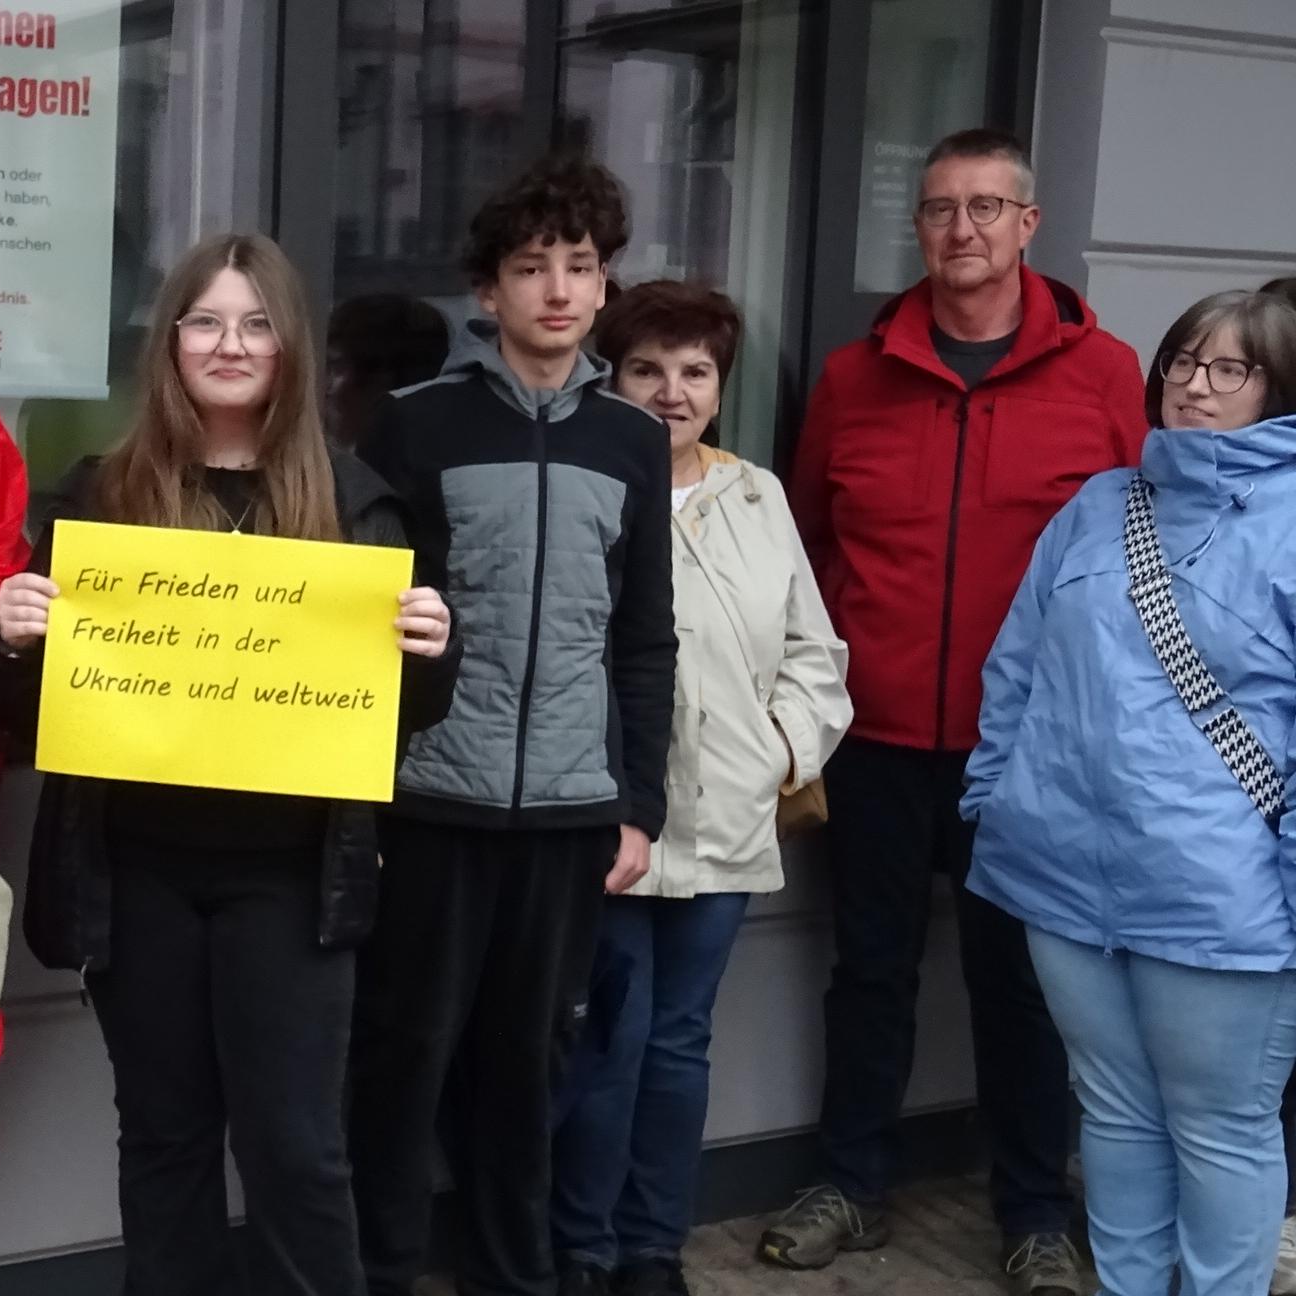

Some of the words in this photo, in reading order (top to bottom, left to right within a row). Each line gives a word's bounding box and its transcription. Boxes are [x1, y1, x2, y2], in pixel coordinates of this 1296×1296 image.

[9, 169, 43, 182] oder
[75, 568, 123, 593] Für
[137, 571, 240, 600] Frieden
[255, 581, 307, 605] und
[72, 618, 180, 647] Freiheit
[195, 628, 220, 650] in
[235, 628, 281, 654] der
[69, 667, 172, 697] Ukraine
[188, 677, 239, 701] und
[254, 682, 375, 710] weltweit
